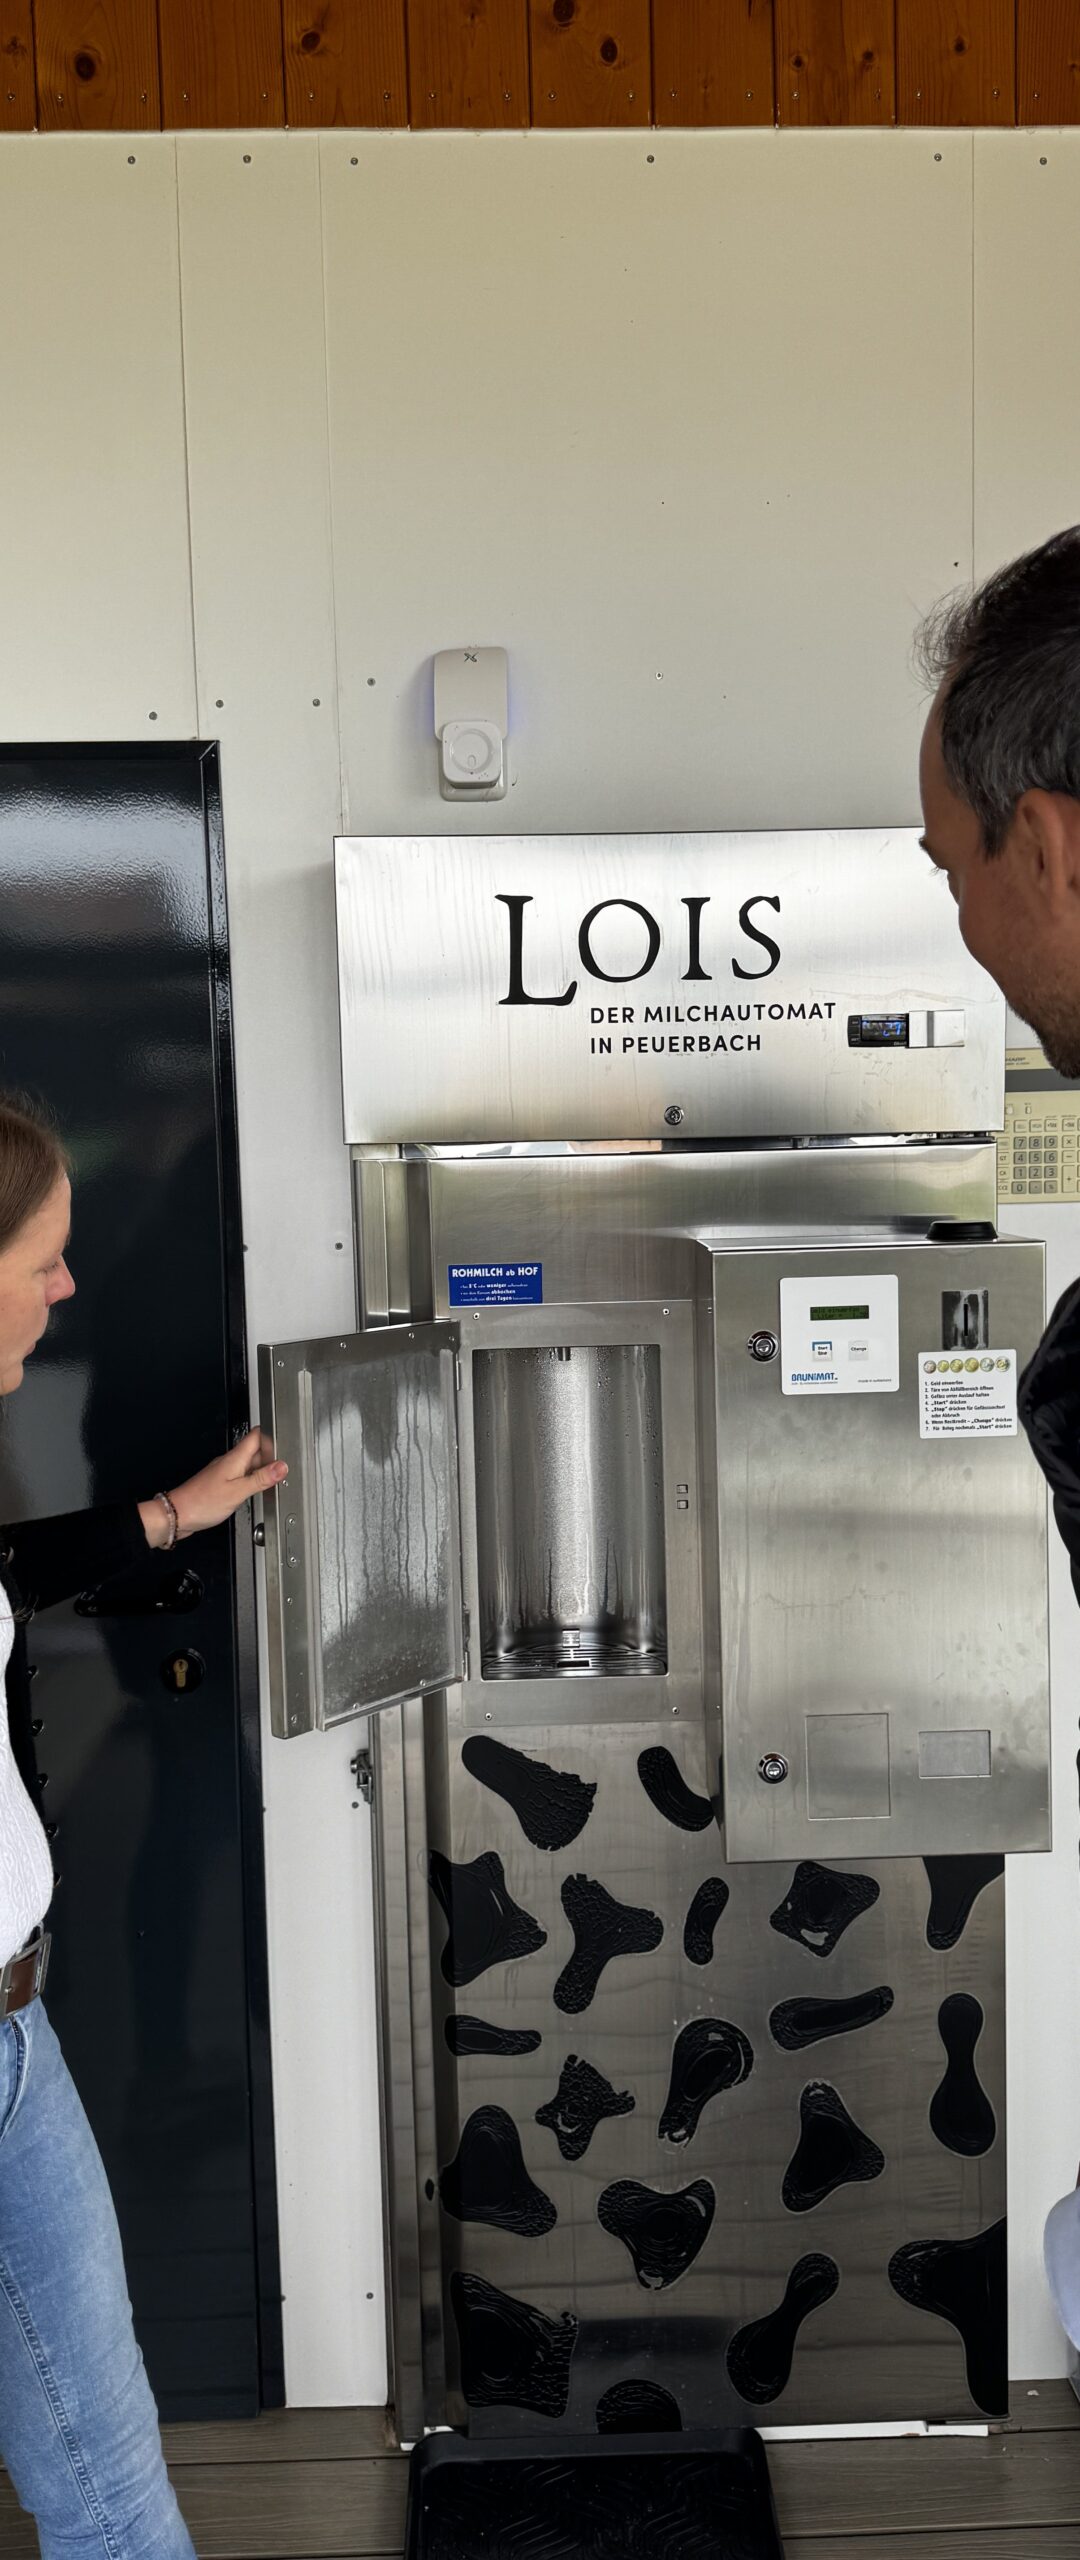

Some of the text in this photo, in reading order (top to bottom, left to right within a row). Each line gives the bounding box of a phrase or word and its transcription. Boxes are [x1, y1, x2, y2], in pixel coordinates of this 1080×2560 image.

[494, 894, 781, 1007] LOIS
[590, 1002, 836, 1024] DER MILCHAUTOMAT
[590, 1034, 761, 1054] IN PEUERBACH
[1018, 1139, 1024, 1147] 7
[1033, 1139, 1040, 1147] 8
[1048, 1138, 1055, 1147] 9
[1017, 1154, 1023, 1162] 4
[1033, 1154, 1040, 1162] 5
[1048, 1153, 1055, 1161] 6
[1033, 1168, 1039, 1177] 2
[1048, 1168, 1055, 1176] 3
[1016, 1184, 1023, 1192] 0
[452, 1268, 503, 1277] ROHMILCH
[518, 1267, 538, 1276] HOF
